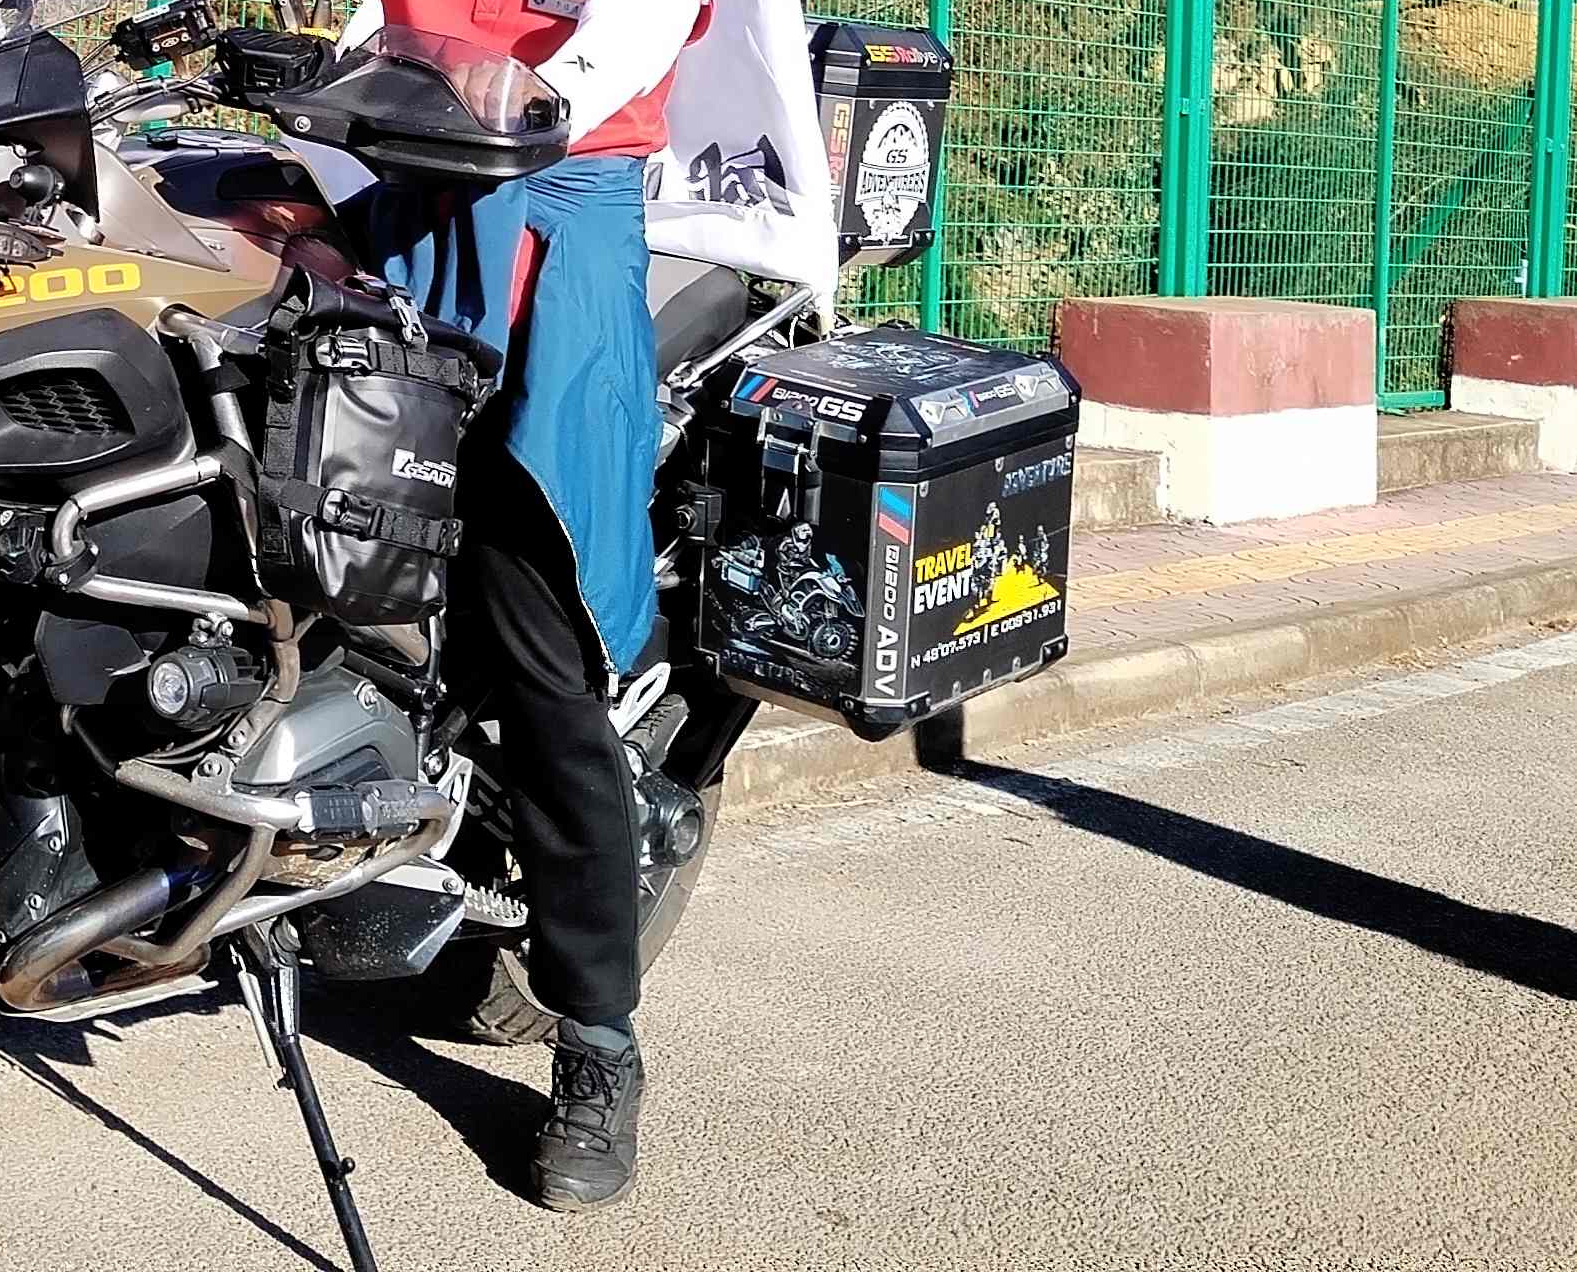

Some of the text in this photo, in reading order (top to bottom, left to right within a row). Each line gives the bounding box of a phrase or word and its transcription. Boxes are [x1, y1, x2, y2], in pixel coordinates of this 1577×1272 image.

[886, 148, 908, 164] GS
[816, 395, 867, 422] GS
[914, 542, 973, 585] TRAVEL
[913, 566, 974, 615] EVENT
[874, 624, 899, 697] ADV
[910, 654, 921, 670] N
[990, 623, 1000, 638] E
